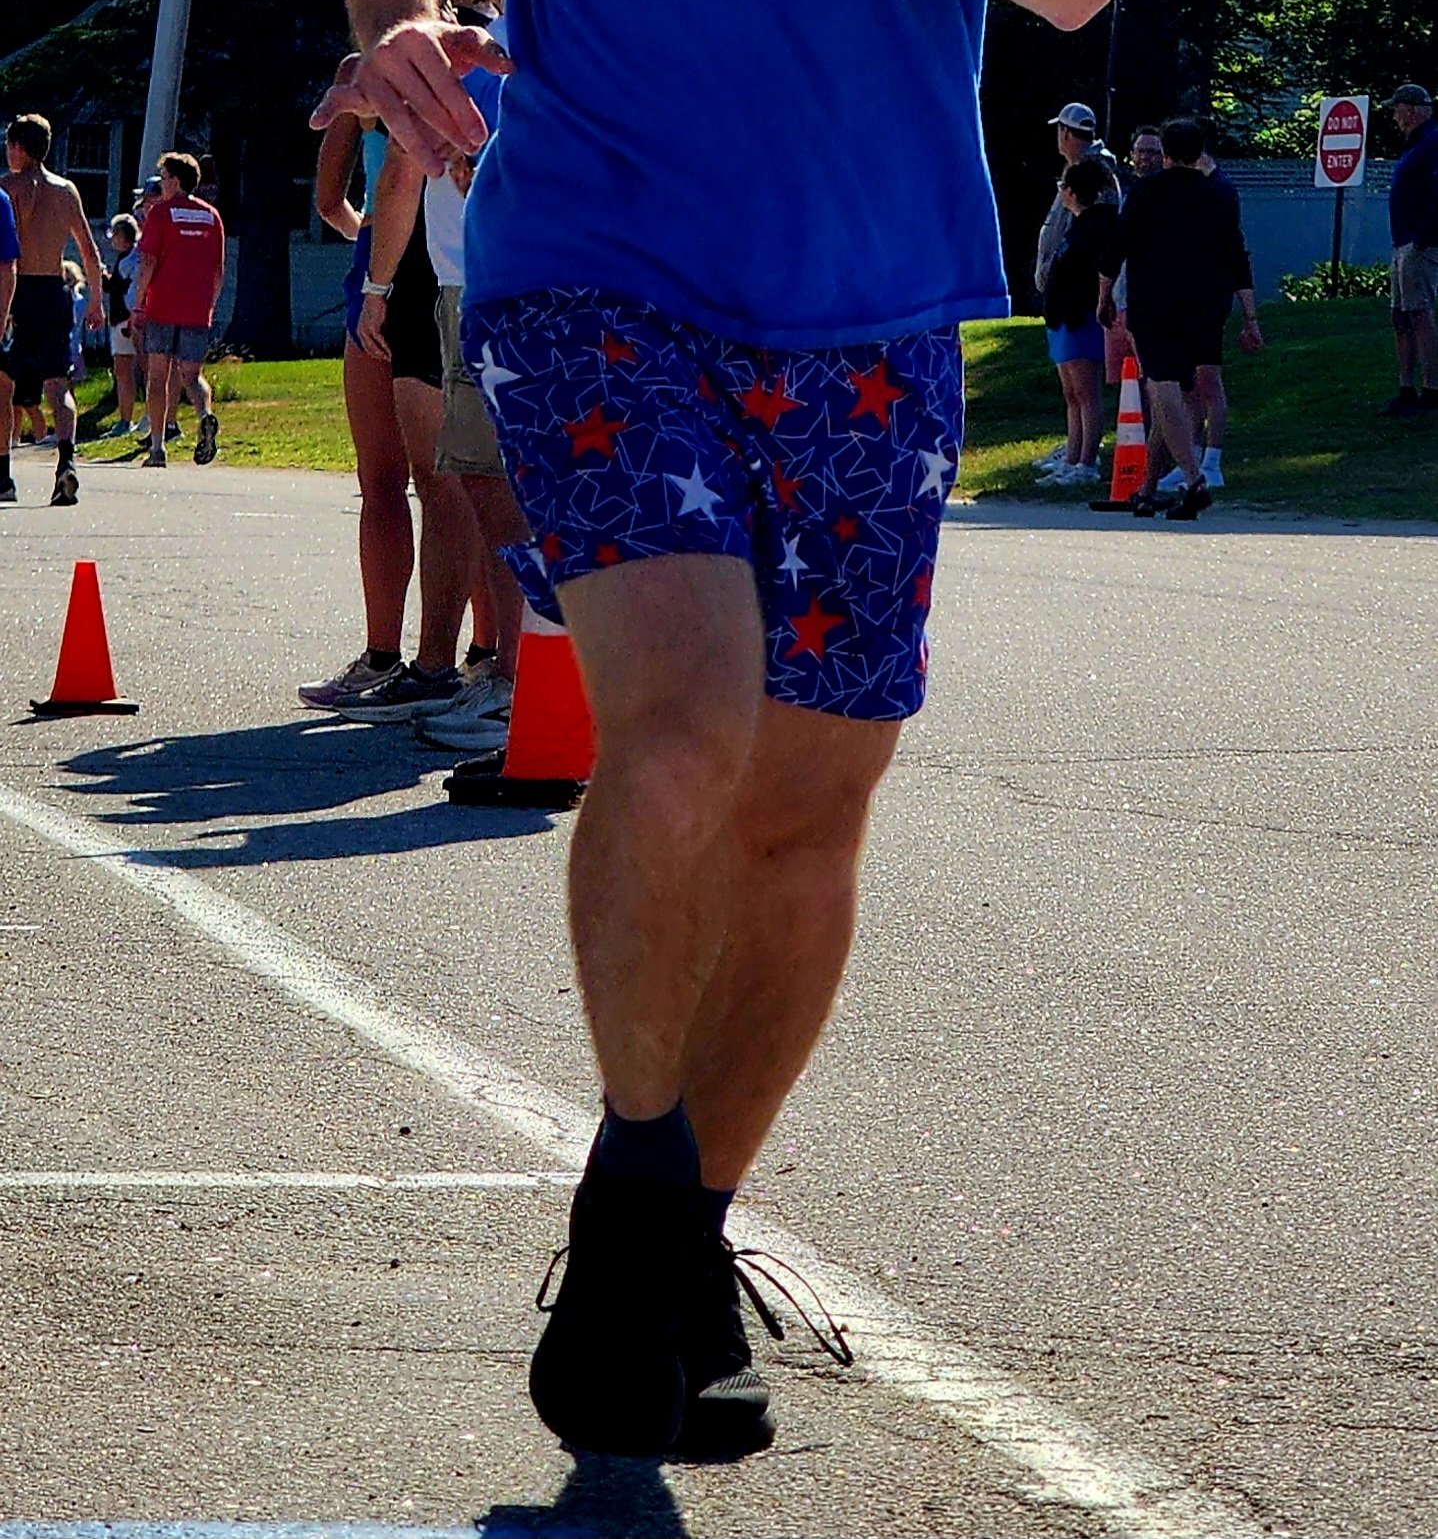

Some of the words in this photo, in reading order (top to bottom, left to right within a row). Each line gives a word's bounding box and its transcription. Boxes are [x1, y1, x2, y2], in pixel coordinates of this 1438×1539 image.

[1327, 116, 1340, 131] DO
[1341, 115, 1359, 130] NOT
[1327, 154, 1353, 169] ENTER
